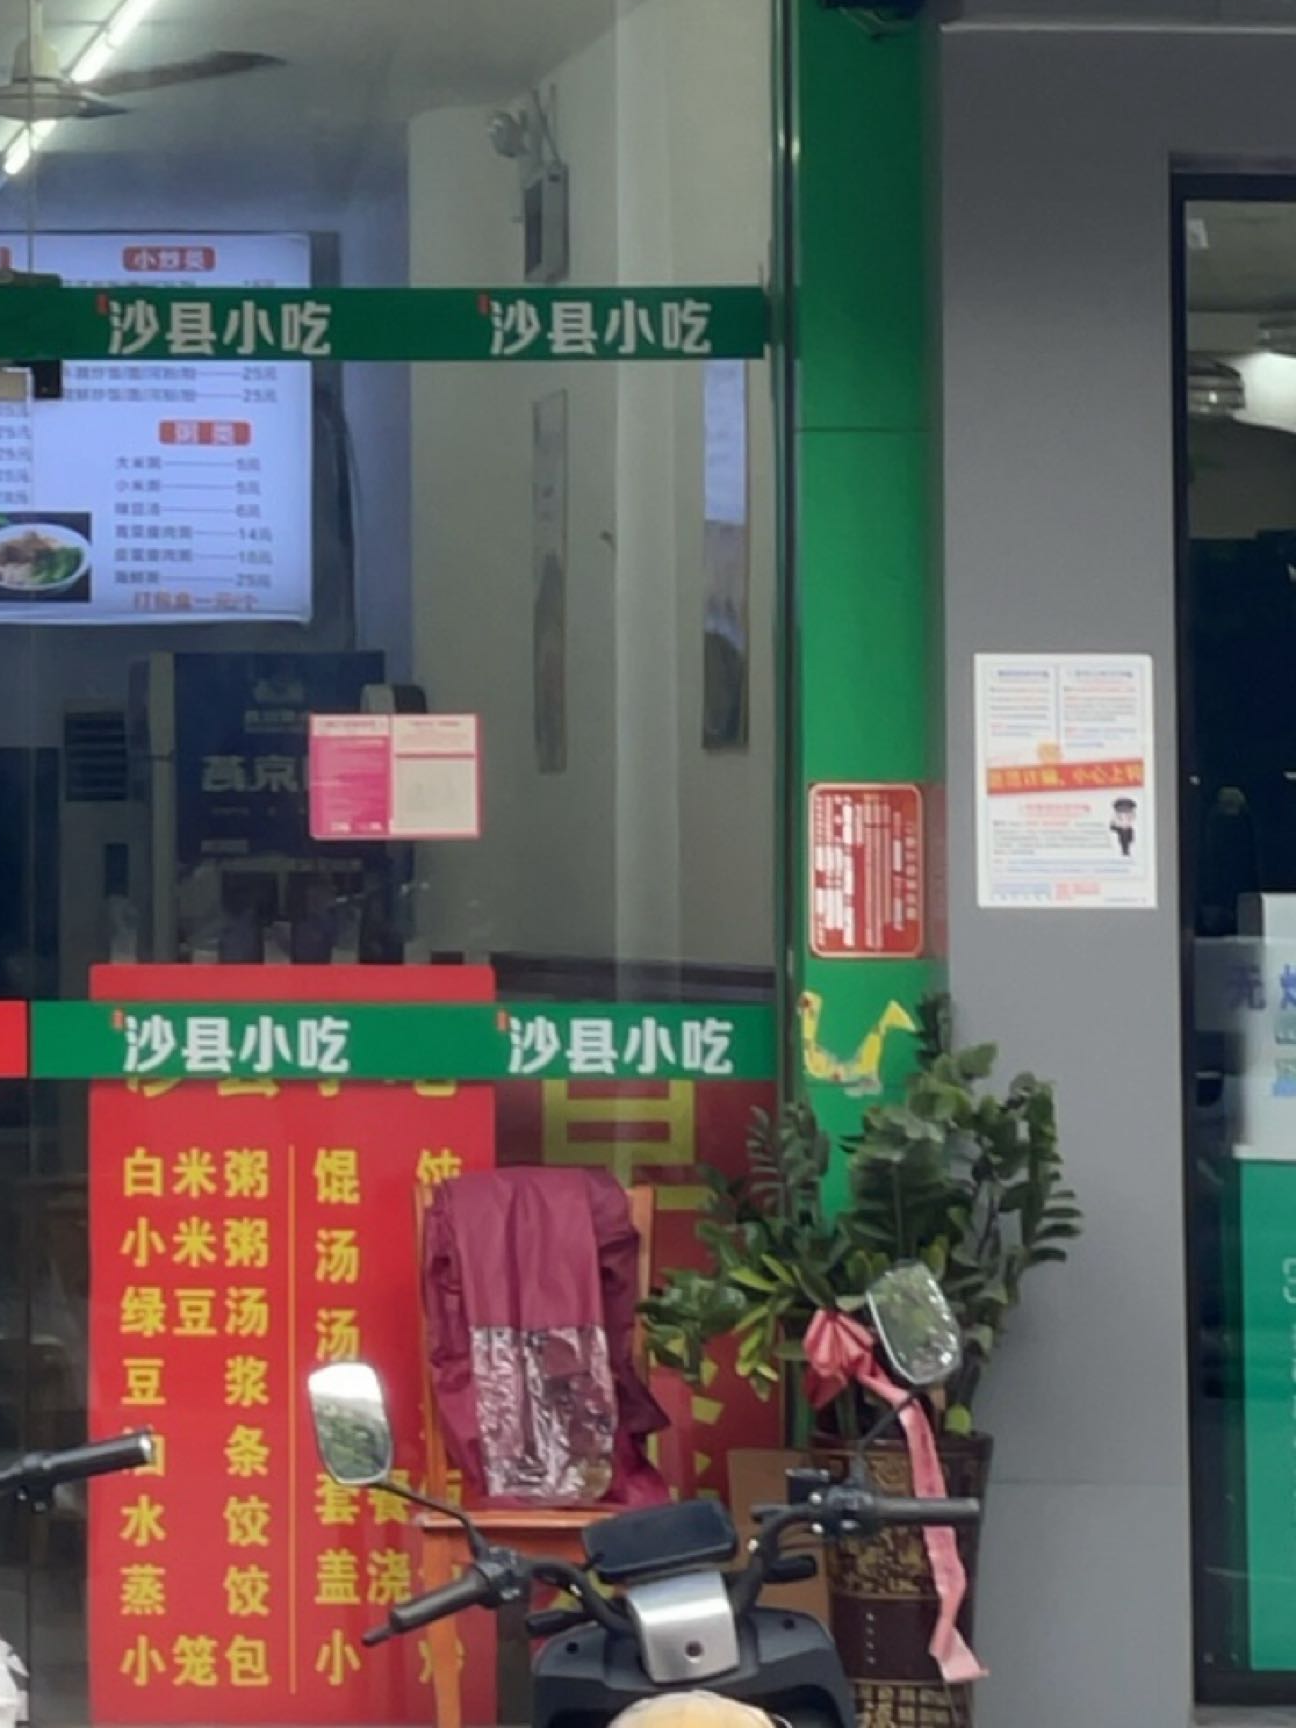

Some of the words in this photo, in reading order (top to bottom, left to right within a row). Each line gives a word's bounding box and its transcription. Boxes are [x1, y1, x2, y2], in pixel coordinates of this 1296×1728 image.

[108, 298, 333, 356] 沙县小吃
[489, 299, 712, 355] 沙县小吃
[123, 1013, 350, 1073] 沙县小吃
[508, 1015, 733, 1075] 沙县小吃
[122, 1147, 270, 1199] 白米粥
[121, 1216, 270, 1268] 小米粥
[120, 1286, 270, 1338] 绿豆汤
[122, 1355, 270, 1407] 豆浆
[121, 1495, 270, 1547] 水饺
[121, 1564, 270, 1616] 蒸饺
[121, 1634, 270, 1687] 小笼包
